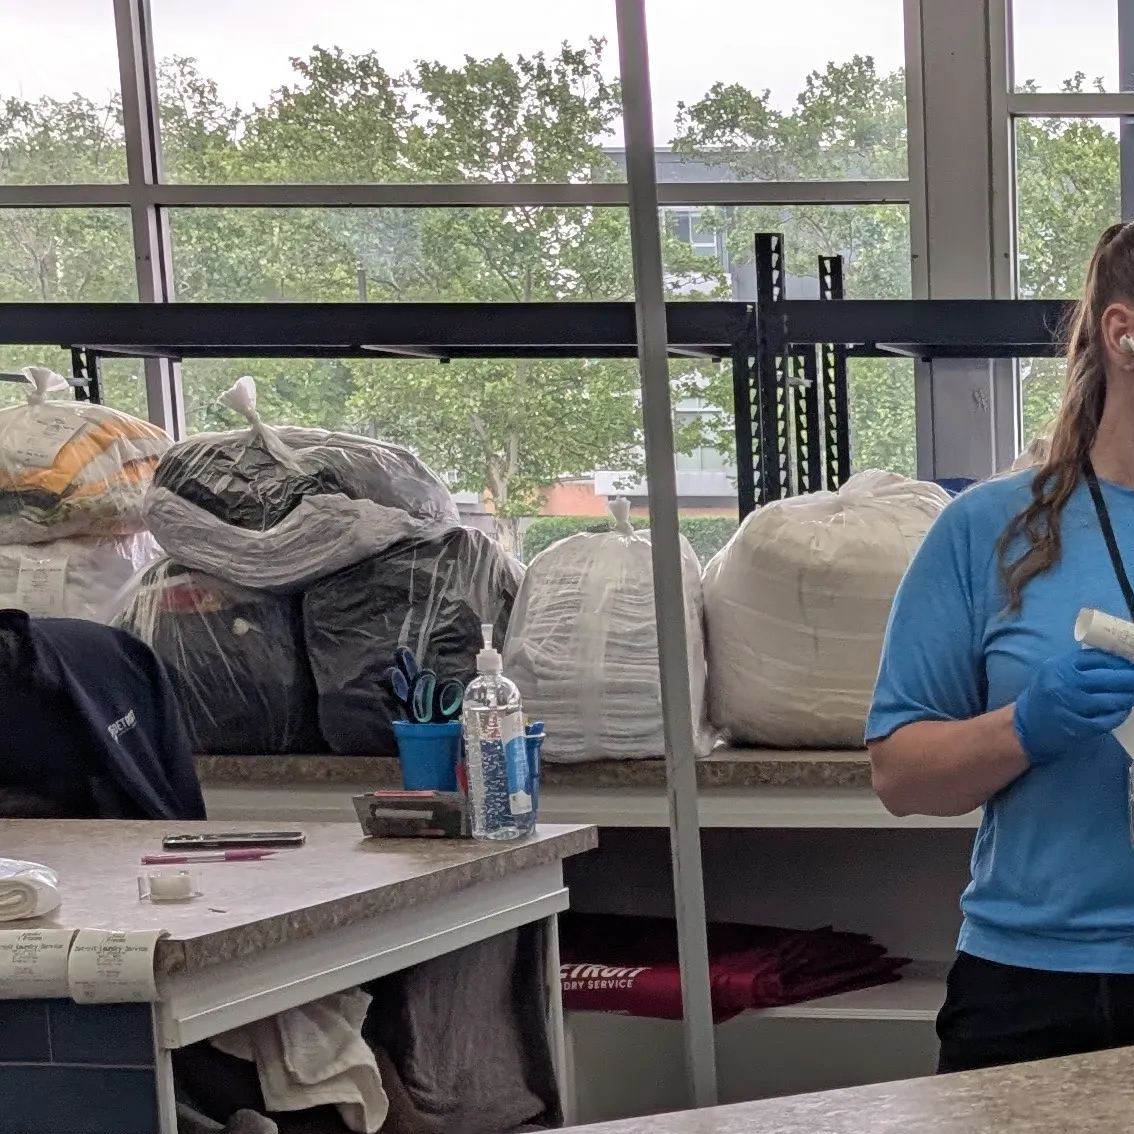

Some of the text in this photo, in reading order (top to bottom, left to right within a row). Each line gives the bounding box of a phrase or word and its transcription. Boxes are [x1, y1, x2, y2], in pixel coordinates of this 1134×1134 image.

[560, 963, 652, 979] ETROIT
[561, 979, 634, 991] DRY SERVICE
